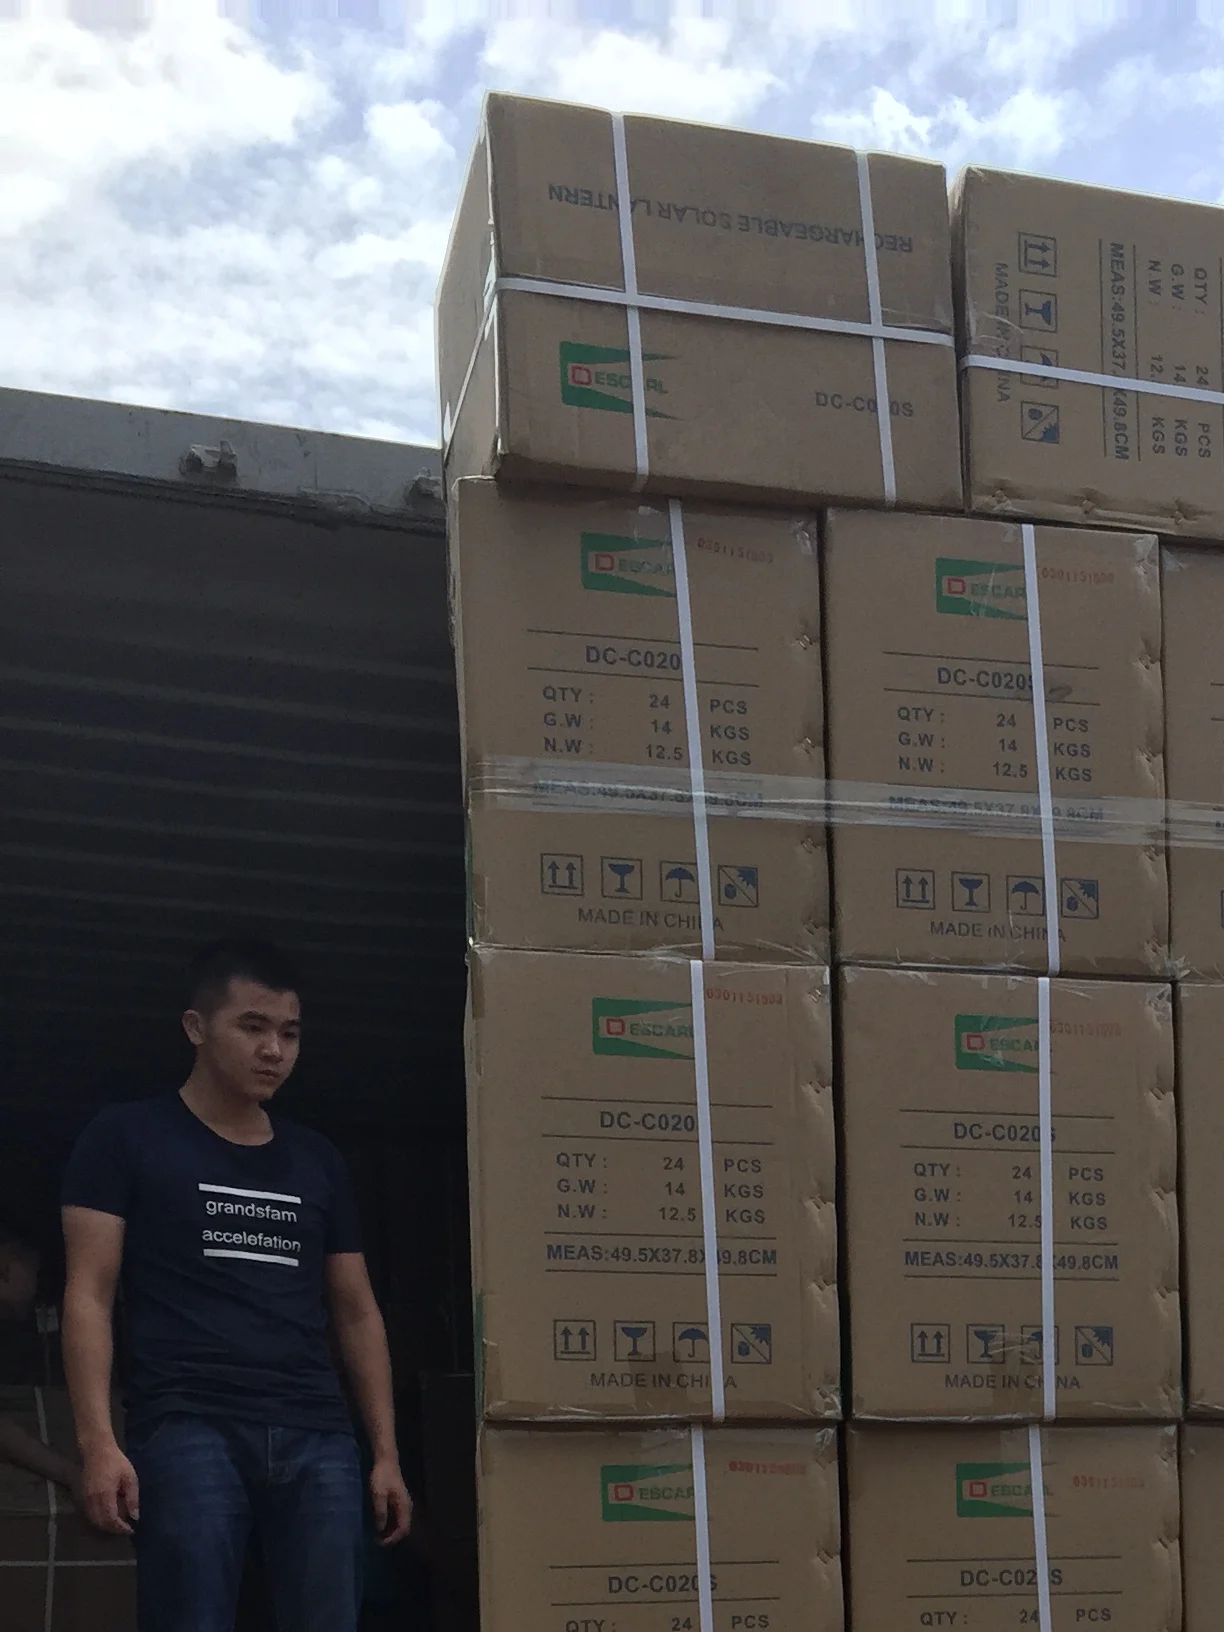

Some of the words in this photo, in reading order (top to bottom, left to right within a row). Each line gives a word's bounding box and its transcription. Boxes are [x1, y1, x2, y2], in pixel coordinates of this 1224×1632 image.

[658, 202, 733, 231] SOLAR
[1150, 355, 1164, 382] 12.
[1172, 364, 1186, 383] 14
[1196, 366, 1208, 385] 24
[814, 391, 914, 417] DC-C00S
[1152, 416, 1165, 454] KGS
[1174, 418, 1187, 457] KGS
[1198, 423, 1211, 458] PCS
[586, 645, 683, 670] DC-C020
[649, 694, 670, 708] 24
[710, 700, 747, 714] PCS
[651, 720, 671, 734] 14
[711, 725, 749, 739] KGS
[996, 714, 1016, 727] 24
[1053, 718, 1088, 732] PCS
[646, 745, 683, 761] 12.5
[712, 750, 751, 766] KGS
[999, 739, 1017, 751] 14
[1054, 743, 1091, 758] KGS
[993, 762, 1028, 778] 12.5
[1055, 767, 1092, 782] KGS
[578, 908, 634, 925] MADE
[640, 911, 658, 926] IN
[930, 921, 983, 938] MADE
[600, 1110, 697, 1133] DC-C020
[663, 1157, 684, 1171] 24
[724, 1158, 762, 1173] PCS
[1012, 1166, 1032, 1180] 24
[1068, 1166, 1104, 1182] PCS
[665, 1181, 685, 1196] 14
[724, 1183, 763, 1199] KGS
[1013, 1190, 1032, 1204] 14
[1068, 1191, 1106, 1206] KGS
[659, 1207, 697, 1222] 12.5
[726, 1209, 765, 1224] KGS
[1008, 1214, 1042, 1229] 12.5
[1070, 1215, 1108, 1230] KGS
[591, 1372, 646, 1388] MADE
[652, 1372, 671, 1388] IN
[945, 1373, 996, 1389] MADE
[1002, 1375, 1018, 1389] IN
[960, 1568, 1063, 1587] DC-C02S
[671, 1617, 692, 1631] 24
[731, 1614, 769, 1629] PCS
[1020, 1609, 1039, 1624] 24
[1076, 1608, 1111, 1622] PCS
